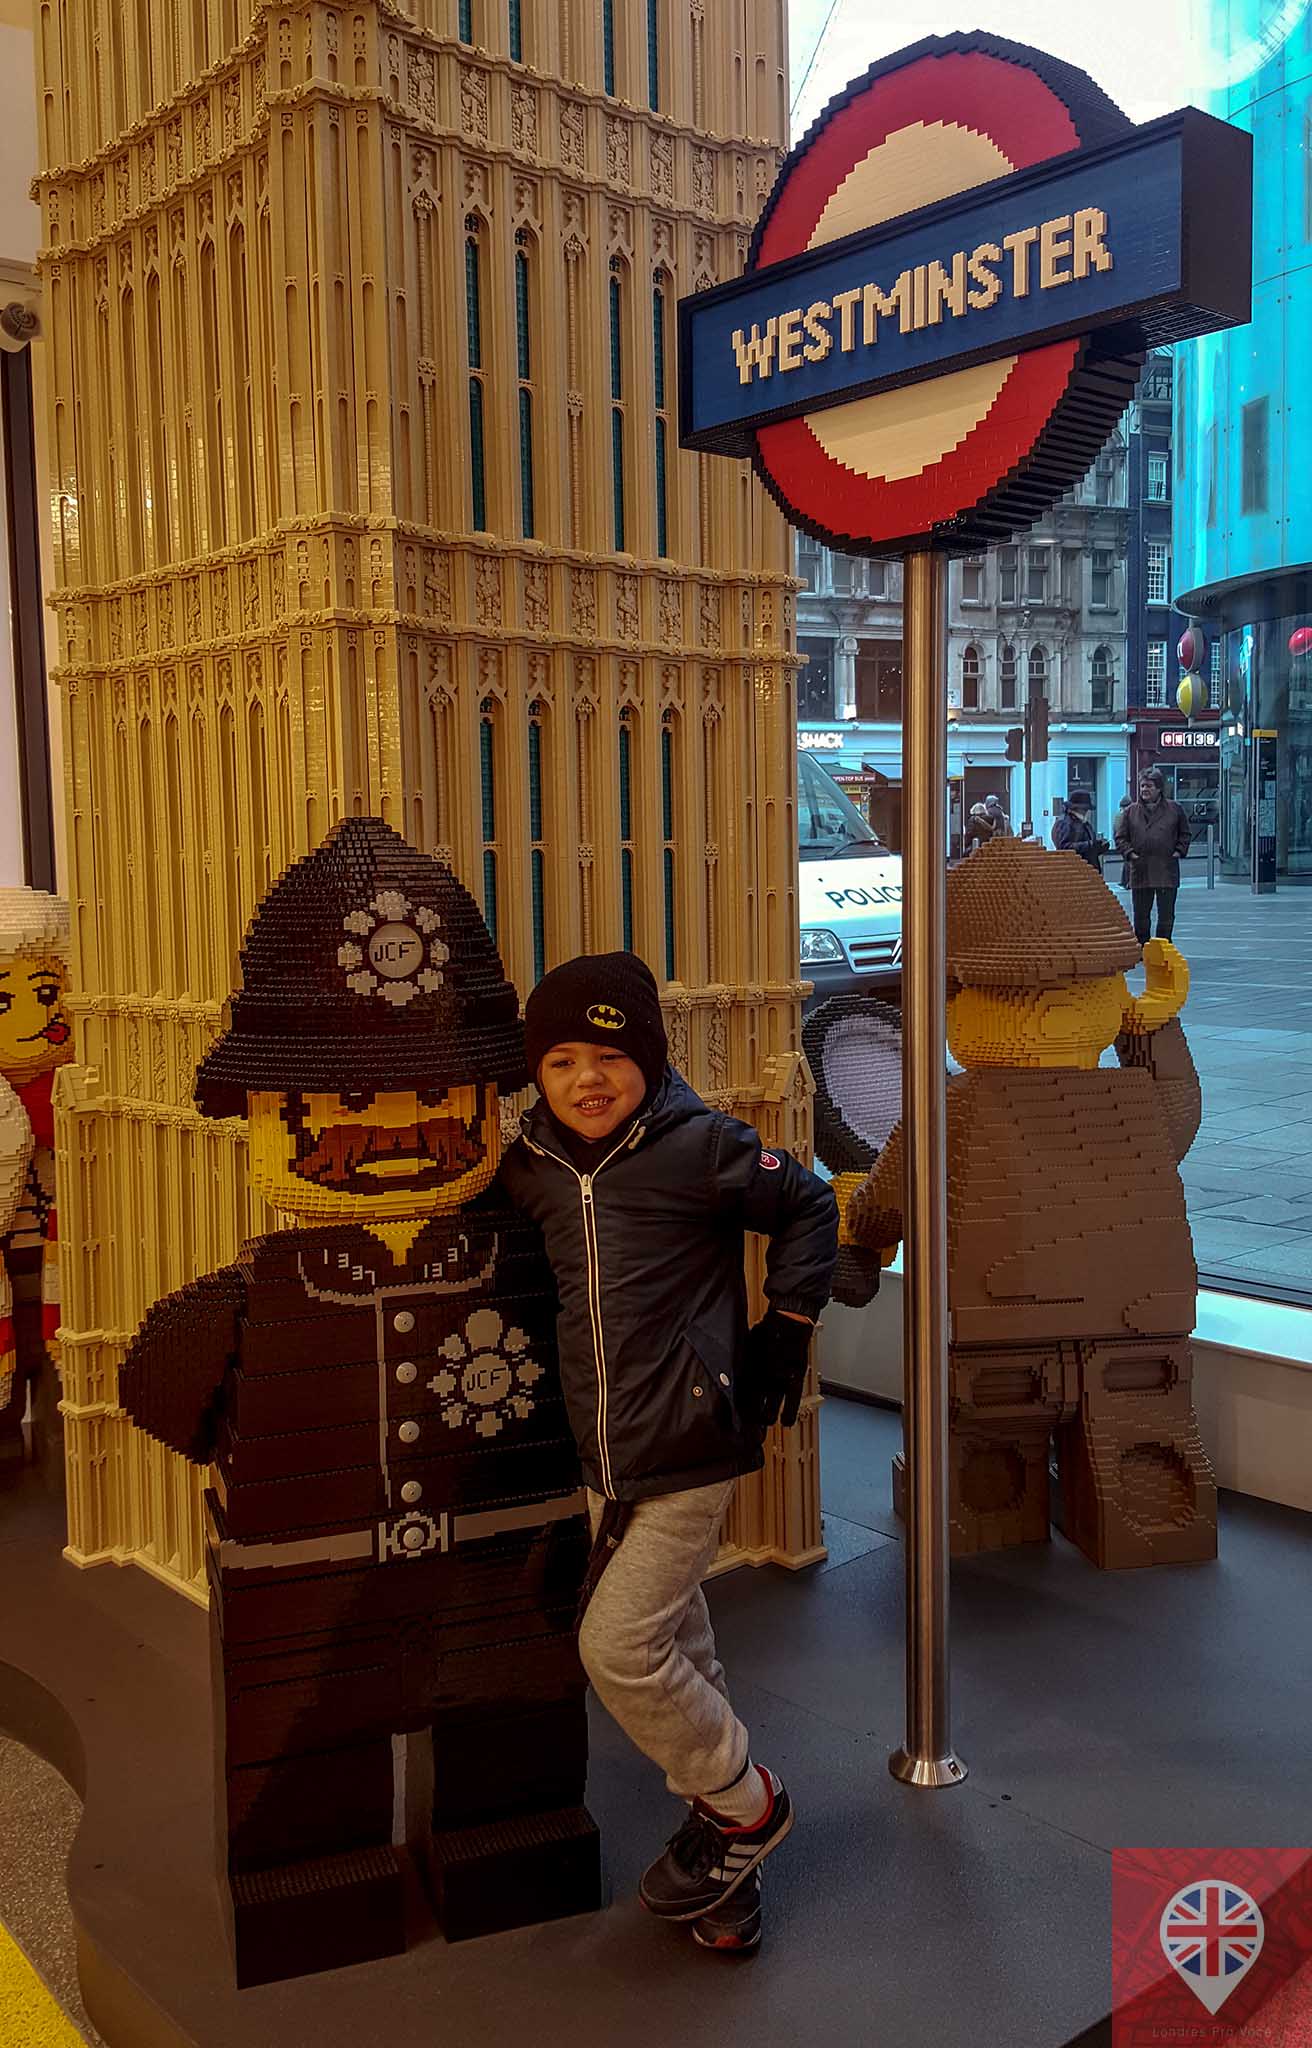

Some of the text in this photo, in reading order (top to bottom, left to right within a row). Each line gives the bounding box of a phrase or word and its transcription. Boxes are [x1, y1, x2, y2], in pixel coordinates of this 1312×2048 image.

[732, 206, 1113, 385] WESTMINSTER
[800, 732, 844, 748] SHACK
[825, 886, 903, 909] POLIC
[374, 940, 416, 962] JCF
[466, 1367, 507, 1391] JCF
